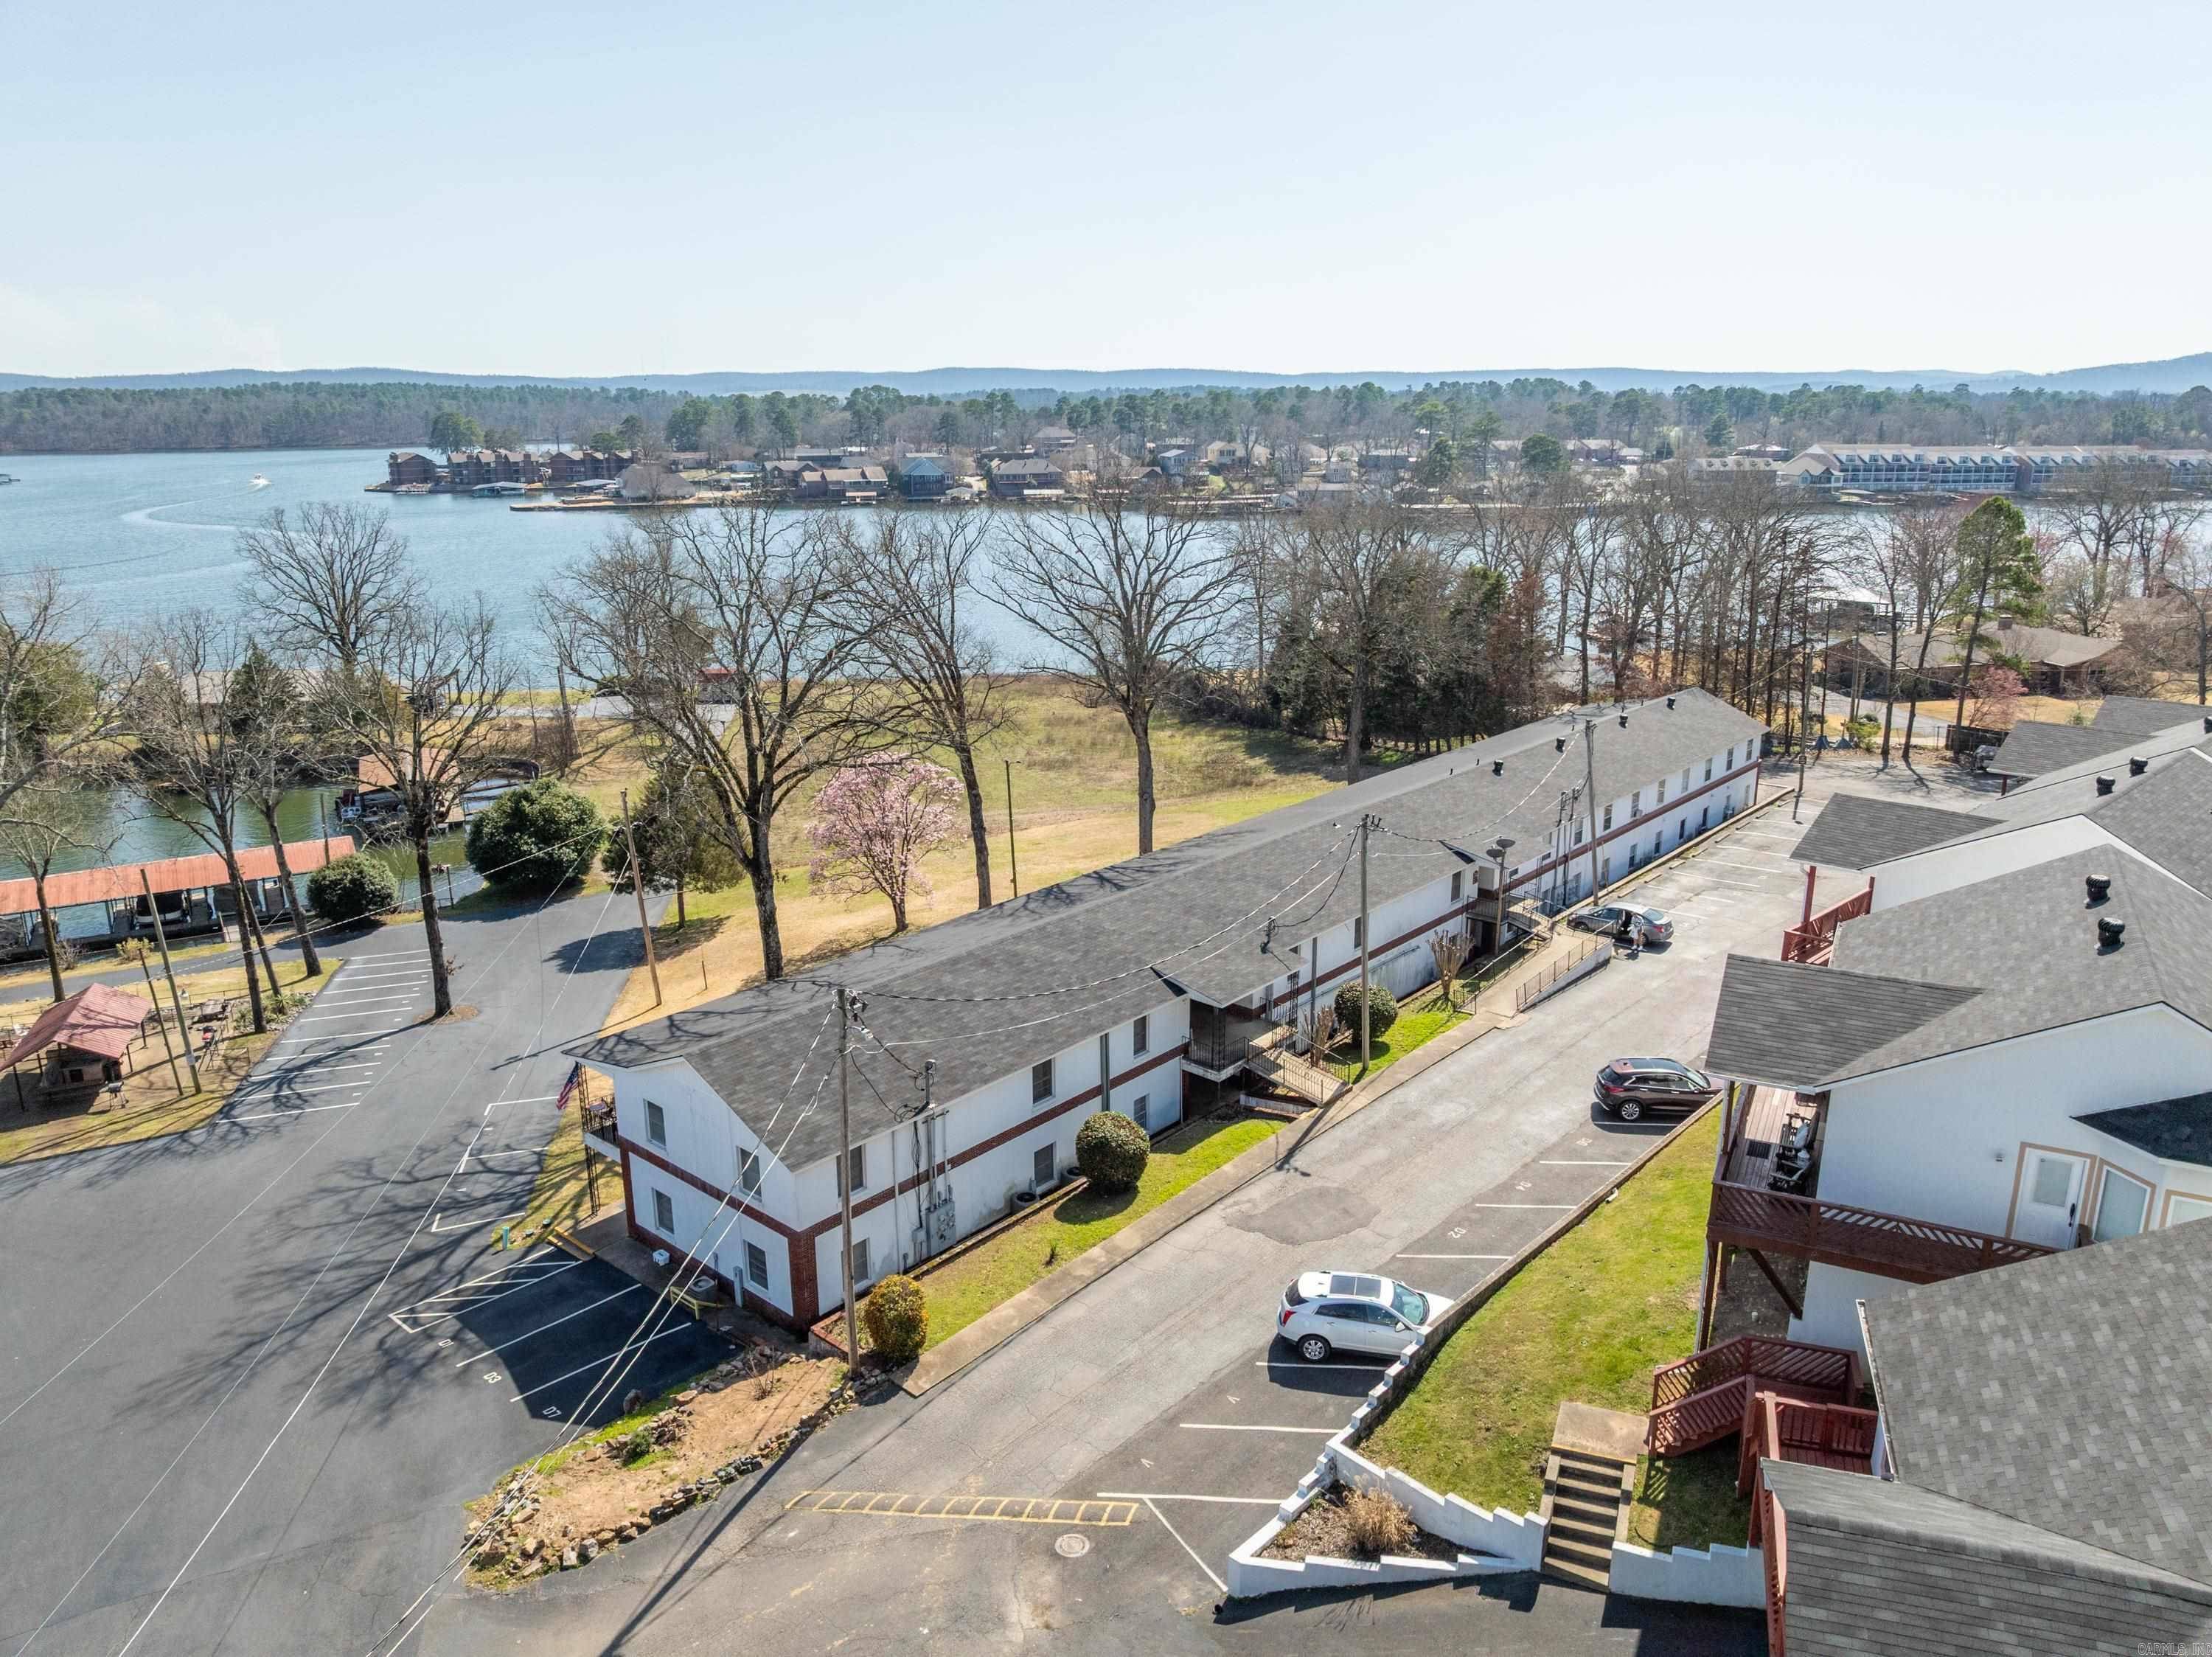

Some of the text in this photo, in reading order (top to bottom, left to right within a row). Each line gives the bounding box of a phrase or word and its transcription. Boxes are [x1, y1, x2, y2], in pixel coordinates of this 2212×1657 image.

[1447, 1227, 1467, 1239] D2
[483, 1372, 502, 1383] D3
[542, 1406, 562, 1418] D7
